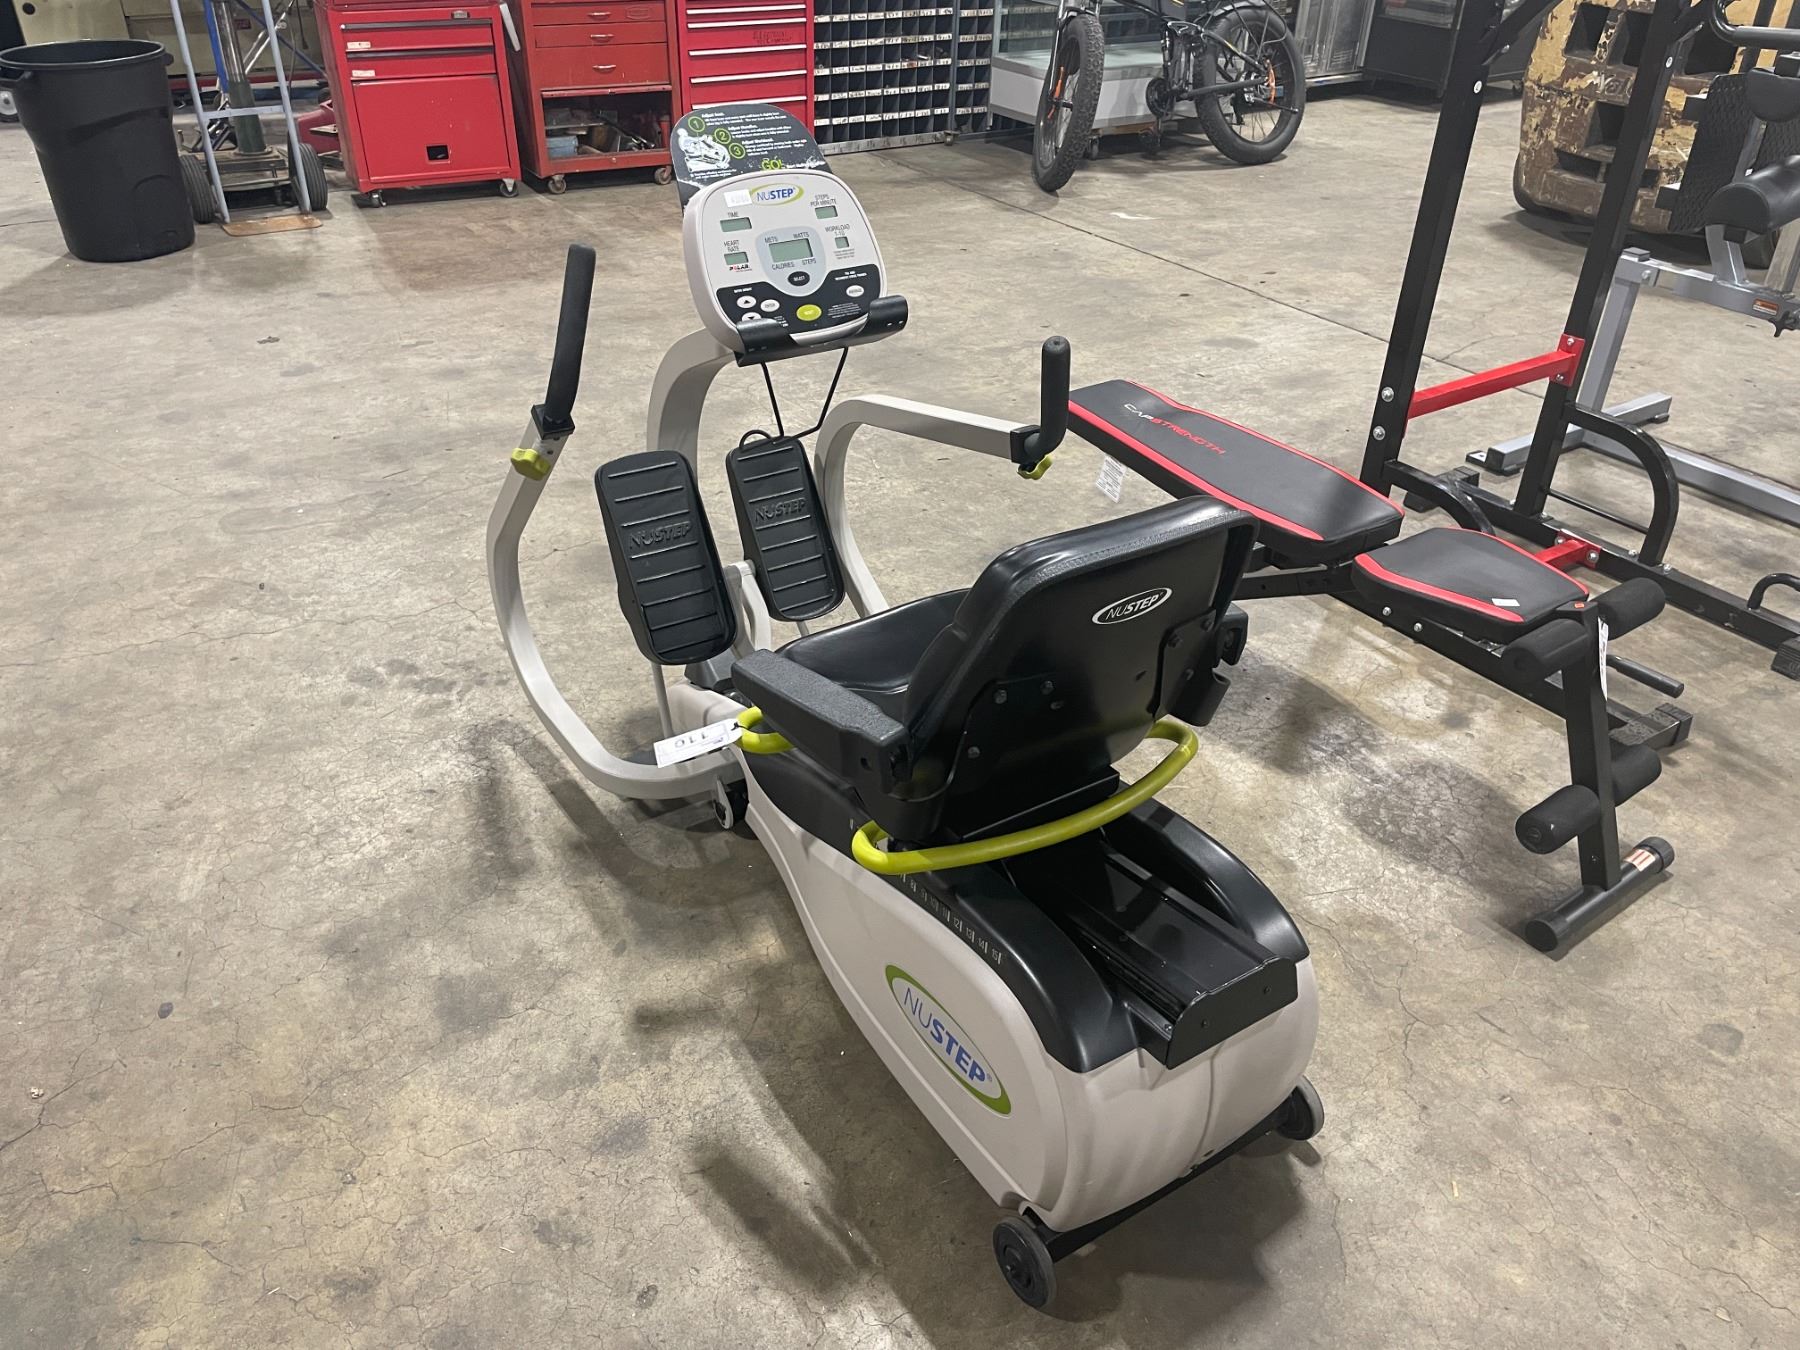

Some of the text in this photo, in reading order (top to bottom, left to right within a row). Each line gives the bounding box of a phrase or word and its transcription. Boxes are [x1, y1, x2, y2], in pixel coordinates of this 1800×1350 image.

[719, 131, 727, 141] 2
[733, 146, 741, 156] 3
[757, 188, 794, 201] NUSTEP
[825, 224, 850, 232] WORKLOAD
[772, 262, 795, 270] CALORIES
[755, 497, 805, 523] NUSTEP
[629, 521, 692, 549] NUSTEP
[1105, 594, 1160, 620] NUSTEP
[953, 917, 960, 929] 12
[965, 927, 973, 940] 13
[978, 938, 985, 950] 14
[991, 948, 999, 960] 15
[904, 987, 986, 1082] NUSTEP
